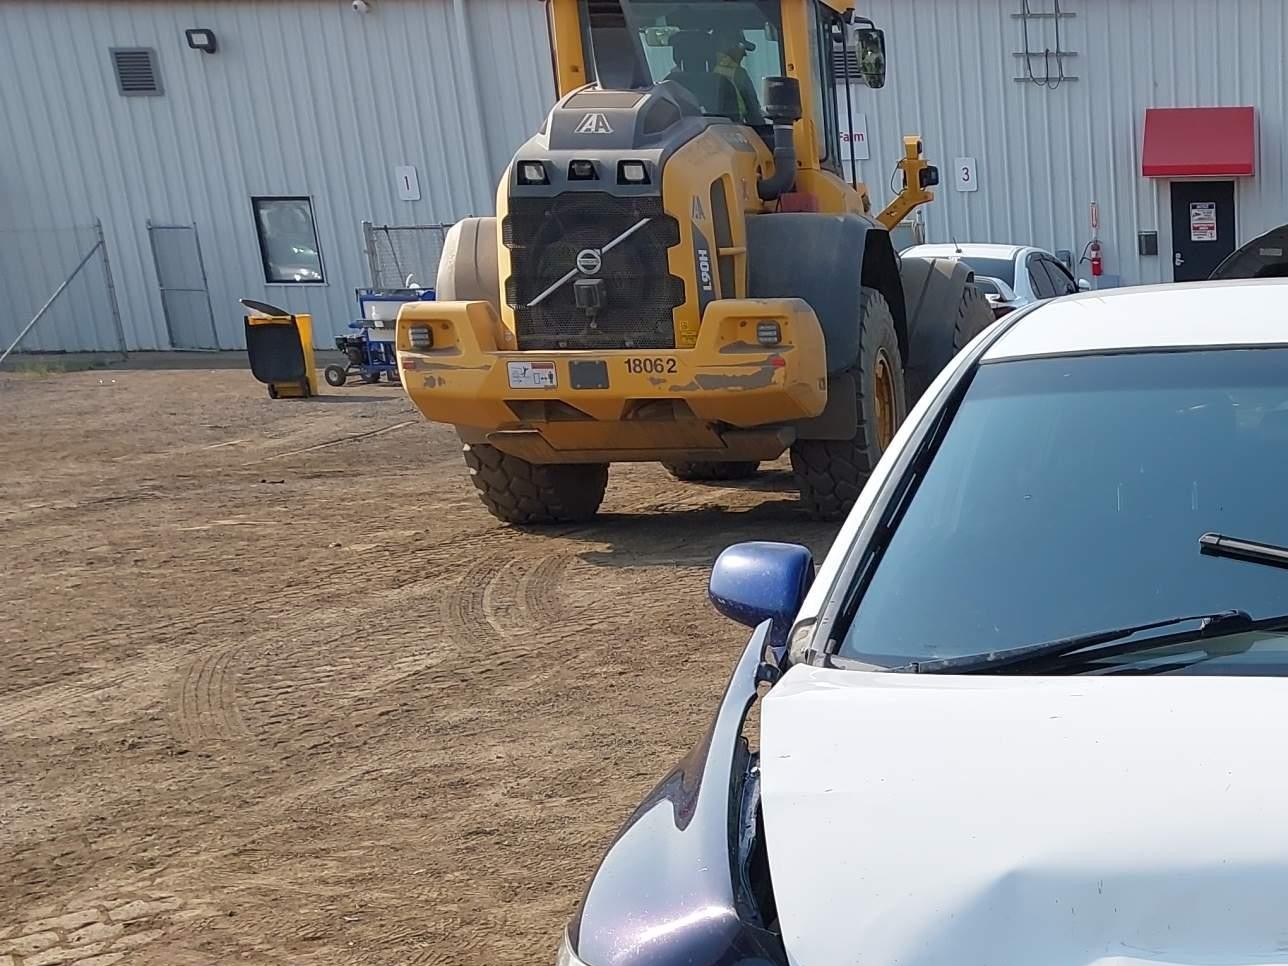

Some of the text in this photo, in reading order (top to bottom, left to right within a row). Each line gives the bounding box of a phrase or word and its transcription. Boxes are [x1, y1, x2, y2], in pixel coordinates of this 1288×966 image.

[839, 132, 865, 142] Fam
[962, 167, 970, 182] 3
[404, 175, 410, 191] 1
[698, 249, 712, 291] L90H
[624, 358, 678, 374] 18062
